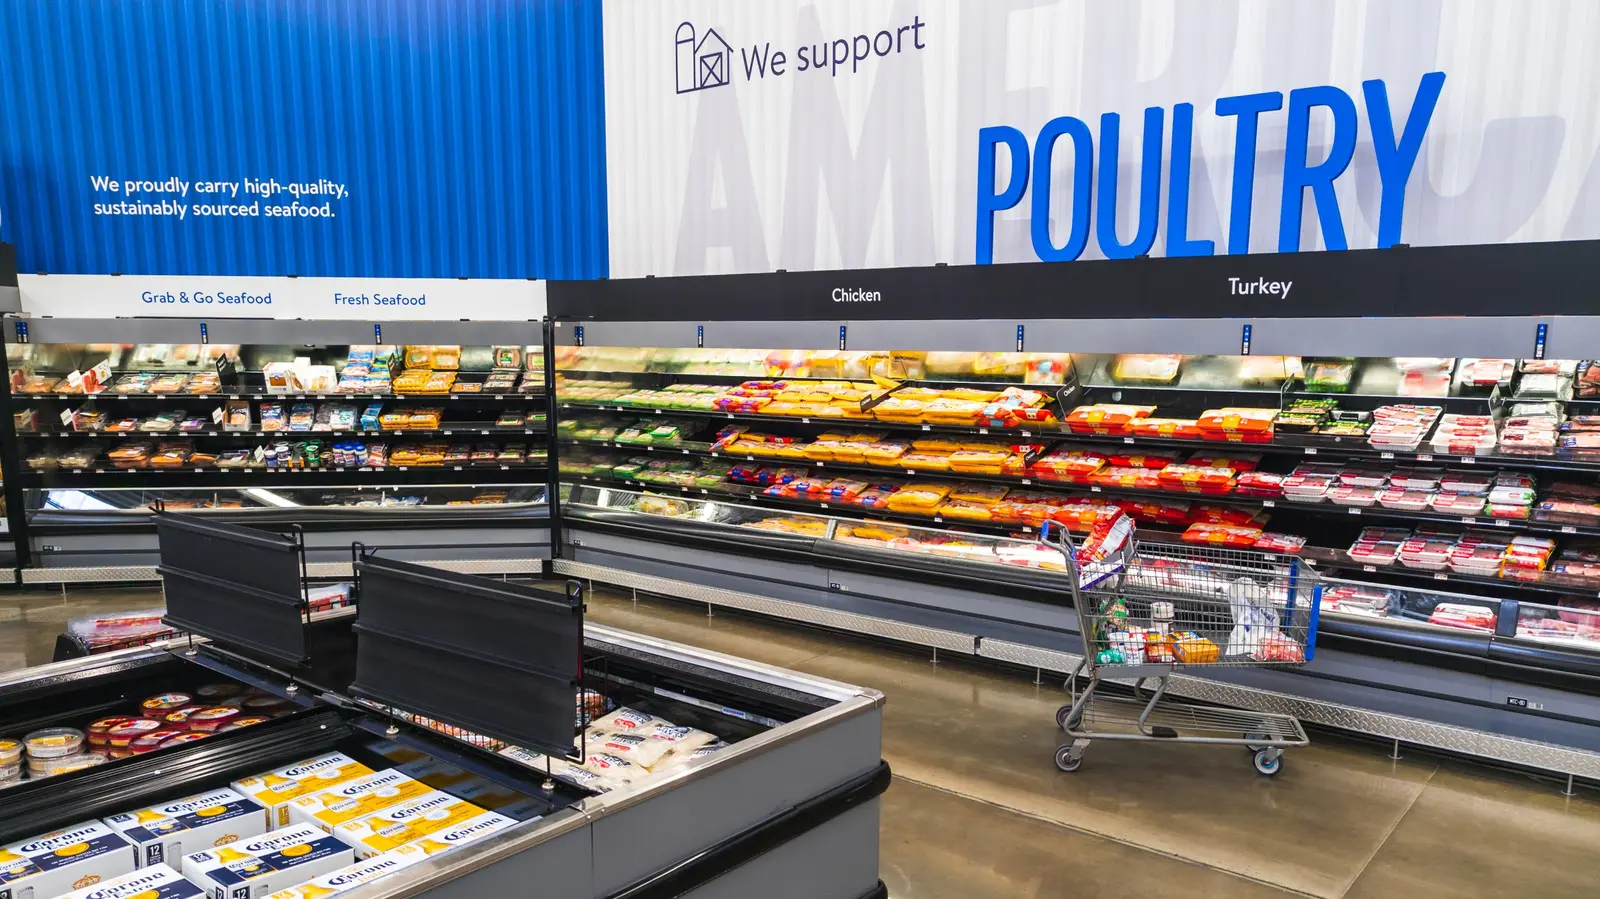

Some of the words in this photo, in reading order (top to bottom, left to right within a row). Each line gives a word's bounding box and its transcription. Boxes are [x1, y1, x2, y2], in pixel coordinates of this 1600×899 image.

[742, 43, 787, 81] We
[797, 16, 926, 77] support
[976, 71, 1447, 266] POULTRY
[90, 175, 120, 193] We
[124, 177, 190, 197] proudly
[194, 180, 240, 198] carry
[244, 177, 349, 200] high-quality,
[94, 200, 188, 220] sustainably
[193, 201, 259, 217] sourced
[264, 202, 336, 218] seafood.
[141, 291, 175, 304] Grab
[179, 292, 190, 304] &
[193, 292, 214, 304] Go
[217, 291, 272, 305] Seafood
[334, 293, 370, 305] Fresh
[373, 293, 426, 305] Seafood
[831, 287, 881, 302] Chicken
[1227, 277, 1293, 300] Turkey
[285, 756, 344, 776] Corona
[342, 774, 400, 795] Corona
[164, 792, 231, 814] Corona
[390, 796, 449, 819] Corona
[20, 826, 98, 852] Corona
[444, 816, 503, 841] Corona
[149, 844, 161, 856] 12
[245, 829, 314, 851] Corona
[269, 838, 306, 850] Extra
[328, 860, 398, 885] Corona
[86, 872, 166, 899] Corona
[236, 888, 247, 899] 12
